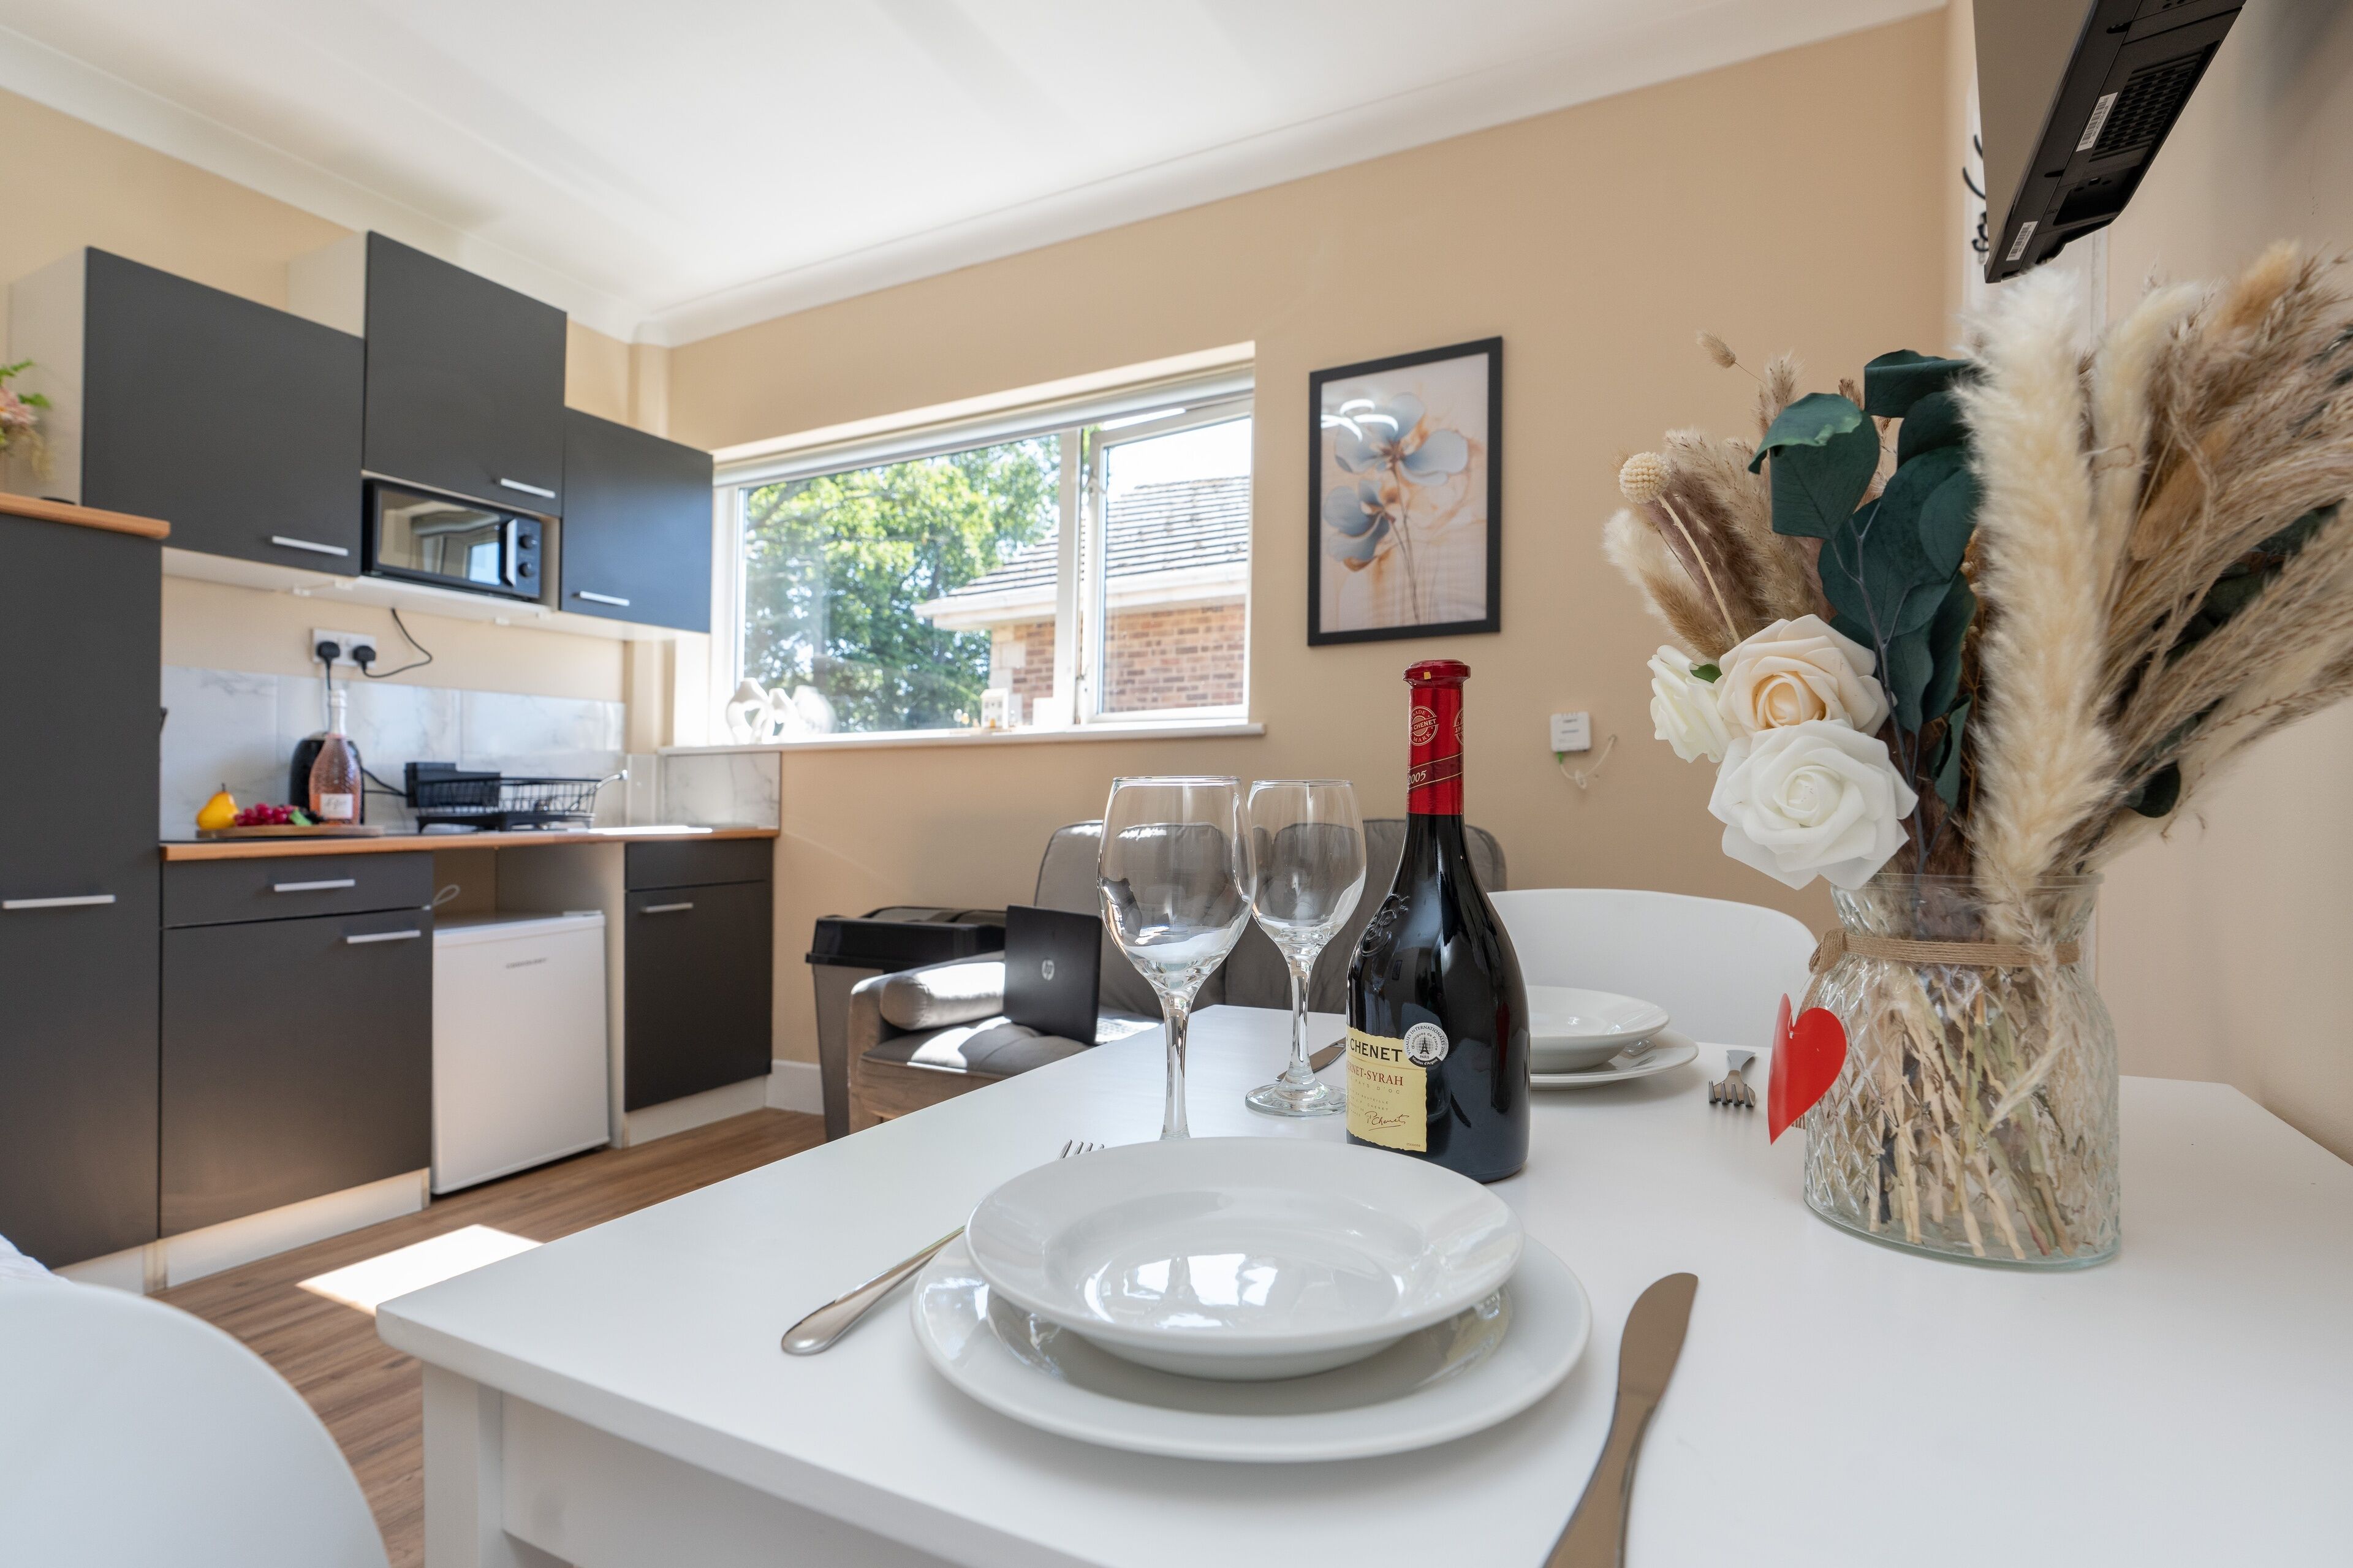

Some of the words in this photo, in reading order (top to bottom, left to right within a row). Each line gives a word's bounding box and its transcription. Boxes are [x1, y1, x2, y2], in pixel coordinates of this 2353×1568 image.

[1411, 710, 1425, 719] TRADE
[1413, 718, 1436, 730] CHENET
[1413, 732, 1431, 742] MARK
[1409, 770, 1427, 784] 2005
[1411, 1025, 1445, 1045] INTERNATIONALES
[1350, 1037, 1403, 1062] CHENET
[1346, 1059, 1404, 1086] ERNET-SYRAH
